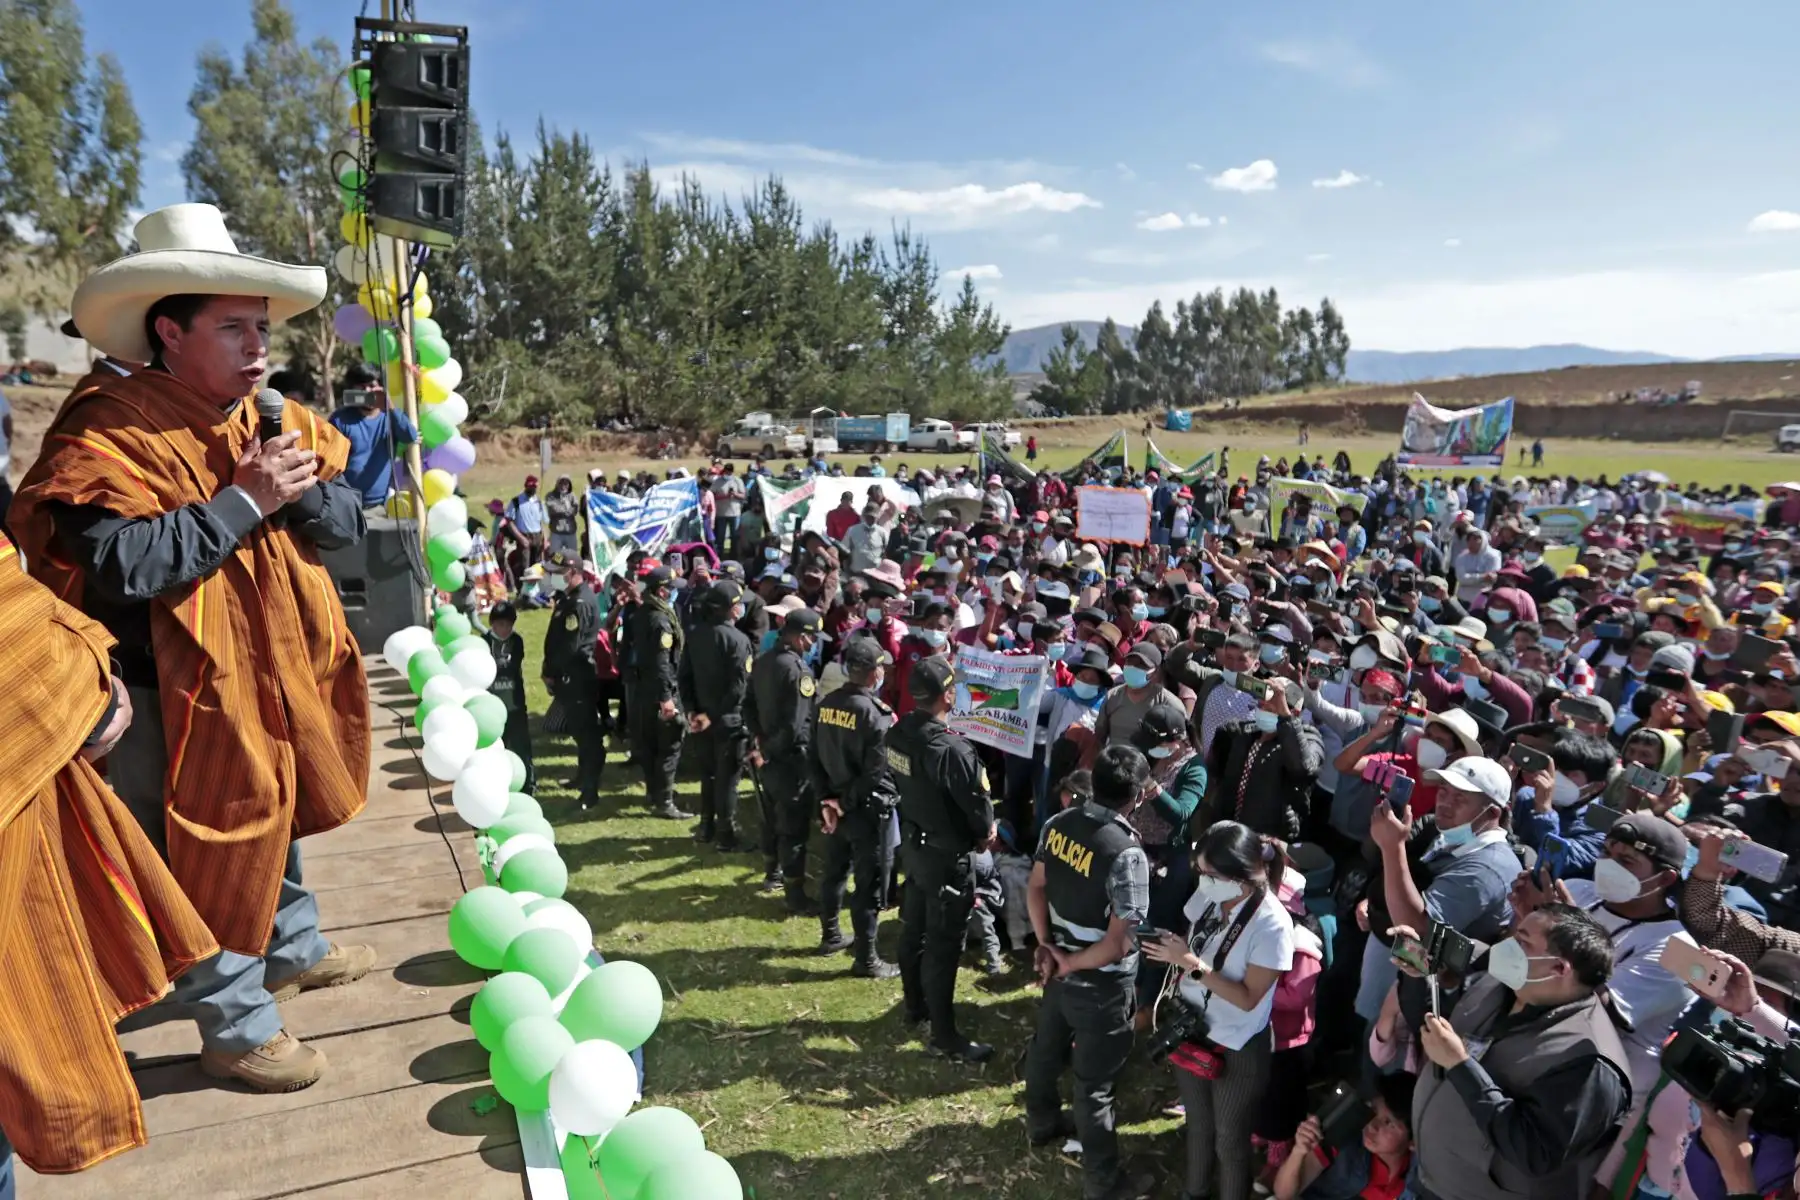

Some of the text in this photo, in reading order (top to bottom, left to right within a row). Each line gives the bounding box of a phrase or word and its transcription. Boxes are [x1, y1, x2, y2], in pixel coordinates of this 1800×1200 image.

[1005, 665, 1039, 675] CASTILLO
[818, 706, 857, 730] POLICIA
[951, 707, 1028, 729] CASCABAMBA
[1044, 828, 1094, 878] POLICIA
